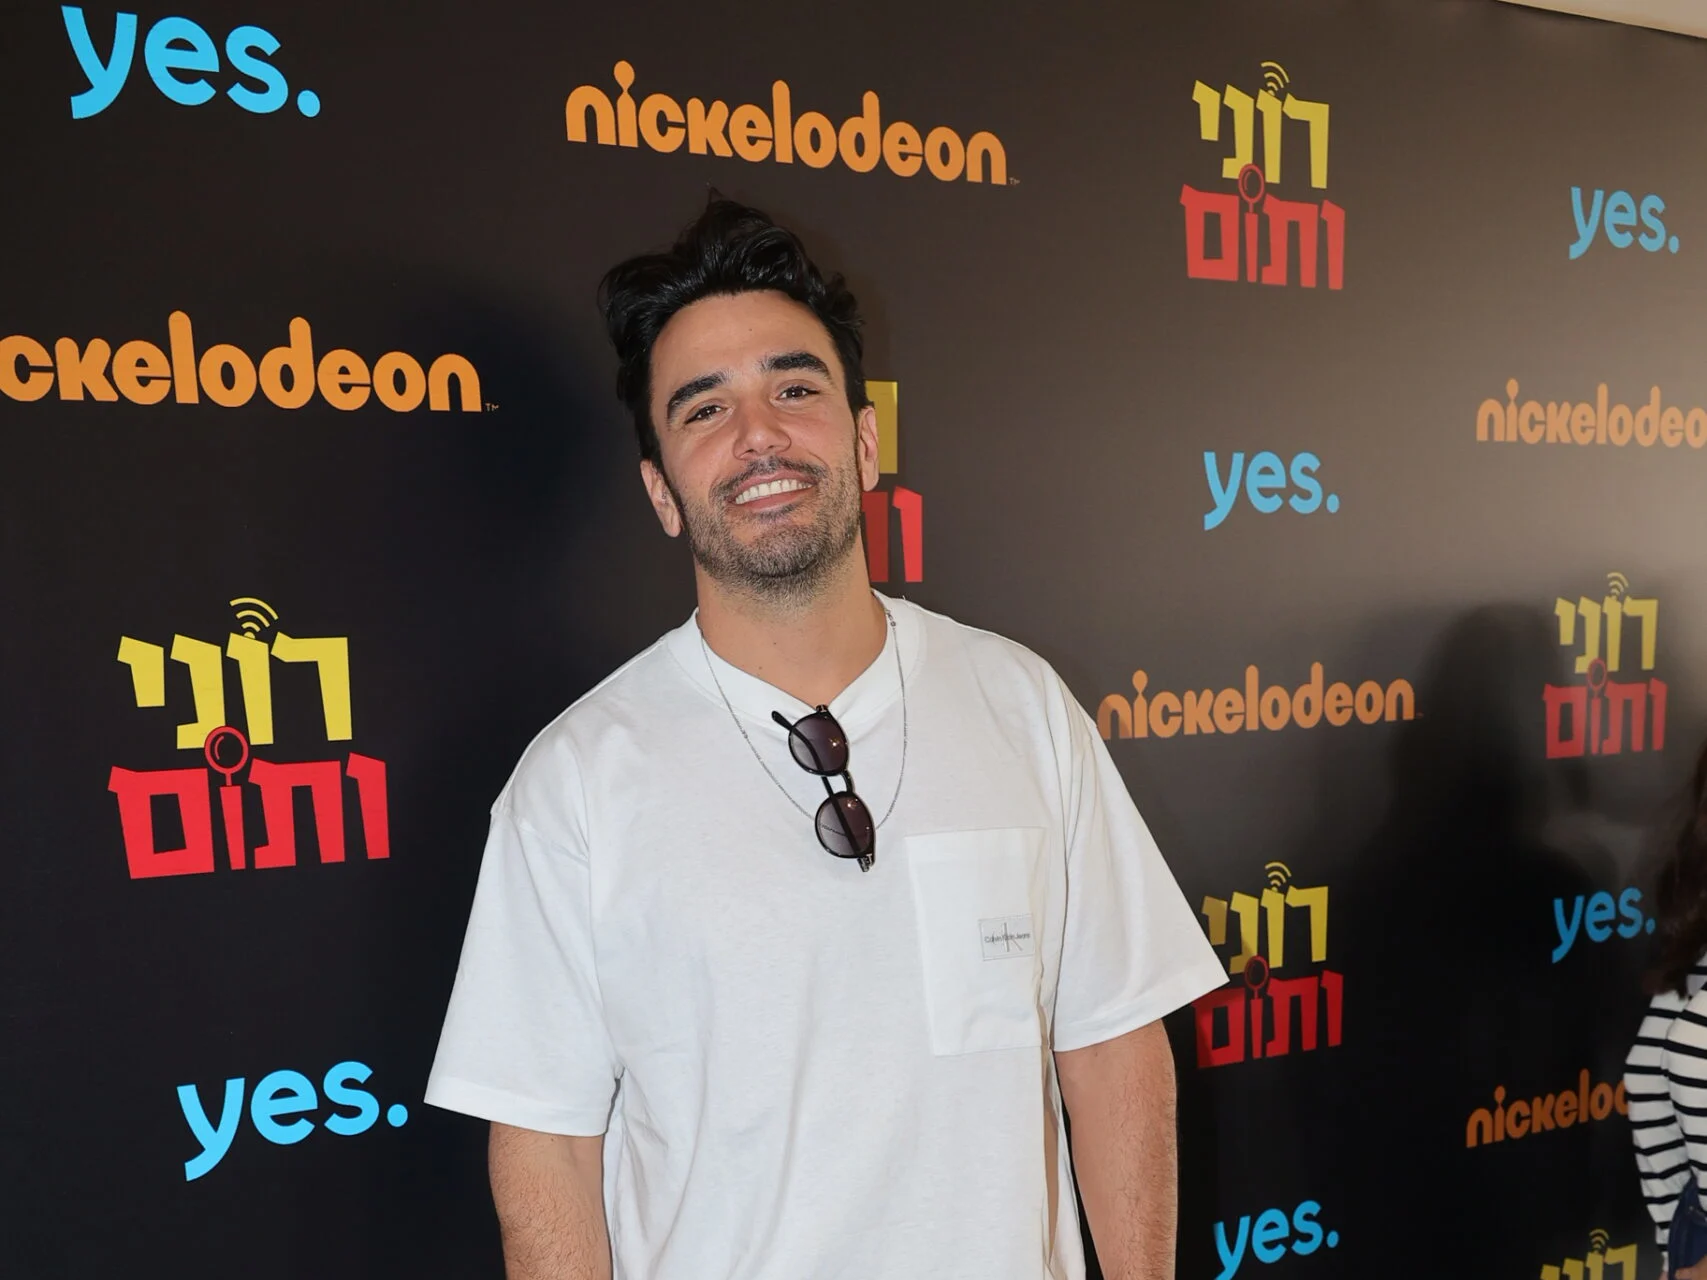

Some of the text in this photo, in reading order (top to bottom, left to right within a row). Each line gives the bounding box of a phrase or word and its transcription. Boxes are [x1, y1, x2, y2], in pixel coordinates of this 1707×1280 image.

[62, 6, 321, 120] yes.
[566, 60, 1008, 186] nickelodeon
[1192, 79, 1330, 190] רוני
[1180, 184, 1346, 291] ותום
[1569, 186, 1679, 259] yes.
[0, 310, 483, 413] ckelodeon
[1476, 378, 1707, 449] nickelodeo
[1203, 450, 1340, 530] yes.
[1554, 596, 1658, 675] רוני
[117, 631, 353, 750] רוני
[1097, 662, 1415, 740] nickelodeon
[1542, 677, 1668, 760] ותום
[108, 752, 391, 880] ותום
[1201, 885, 1329, 975] רוני
[1553, 888, 1655, 963] yes.
[1190, 969, 1344, 1069] ותום
[177, 1061, 409, 1182] yes.
